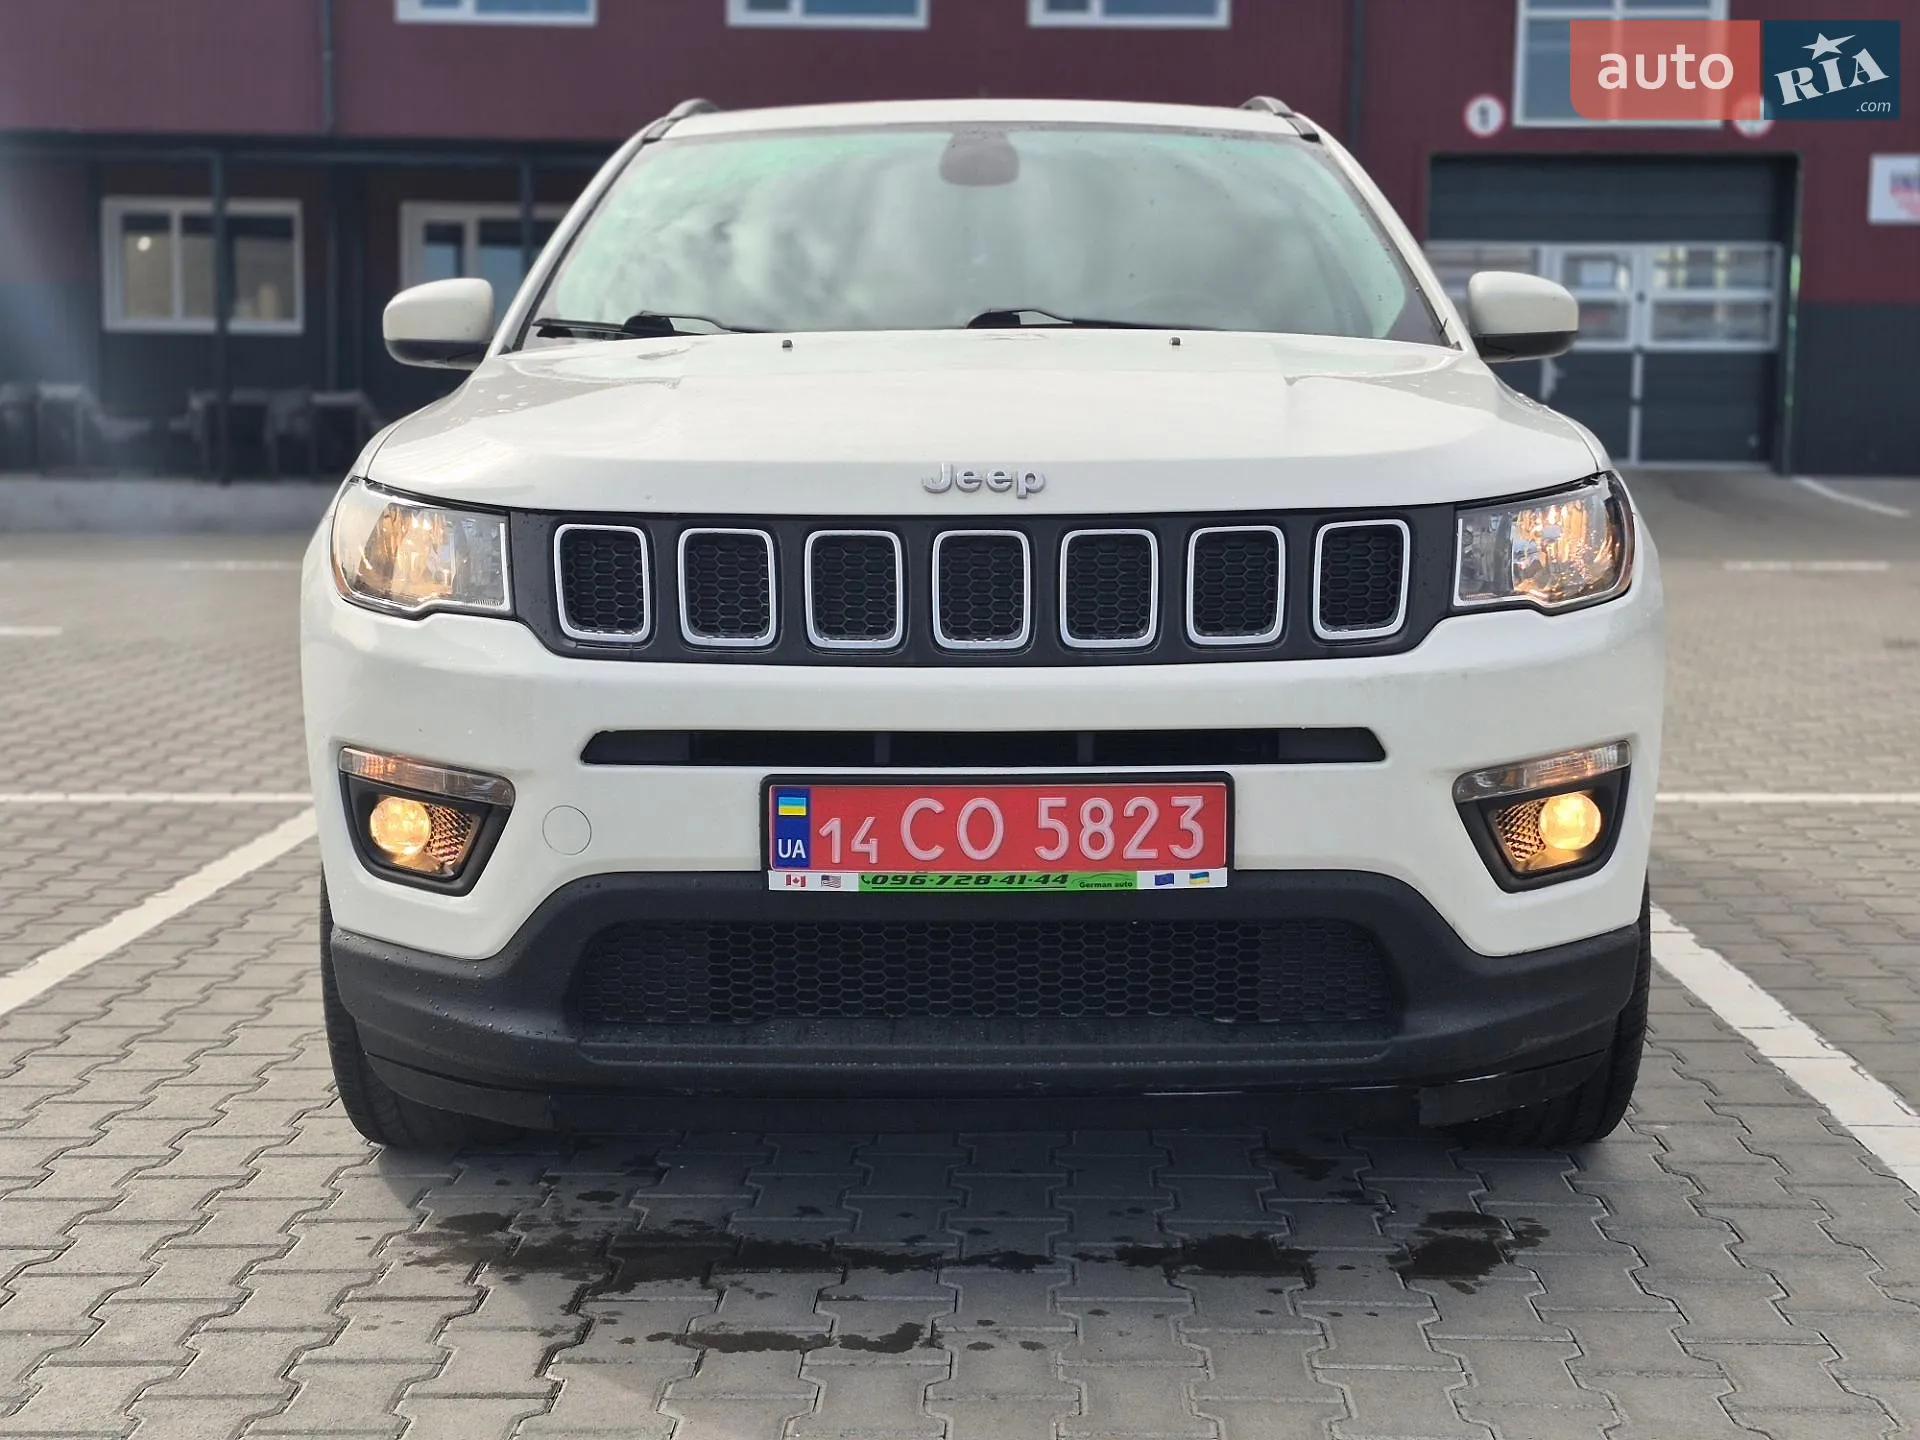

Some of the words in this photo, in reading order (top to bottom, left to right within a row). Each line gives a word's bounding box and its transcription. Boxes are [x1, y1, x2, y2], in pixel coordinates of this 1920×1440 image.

[922, 462, 1046, 499] Jeep
[819, 816, 878, 864] 14
[900, 797, 1005, 861] CO
[1034, 796, 1204, 861] 5823
[778, 838, 807, 859] UA
[1114, 880, 1133, 888] auto
